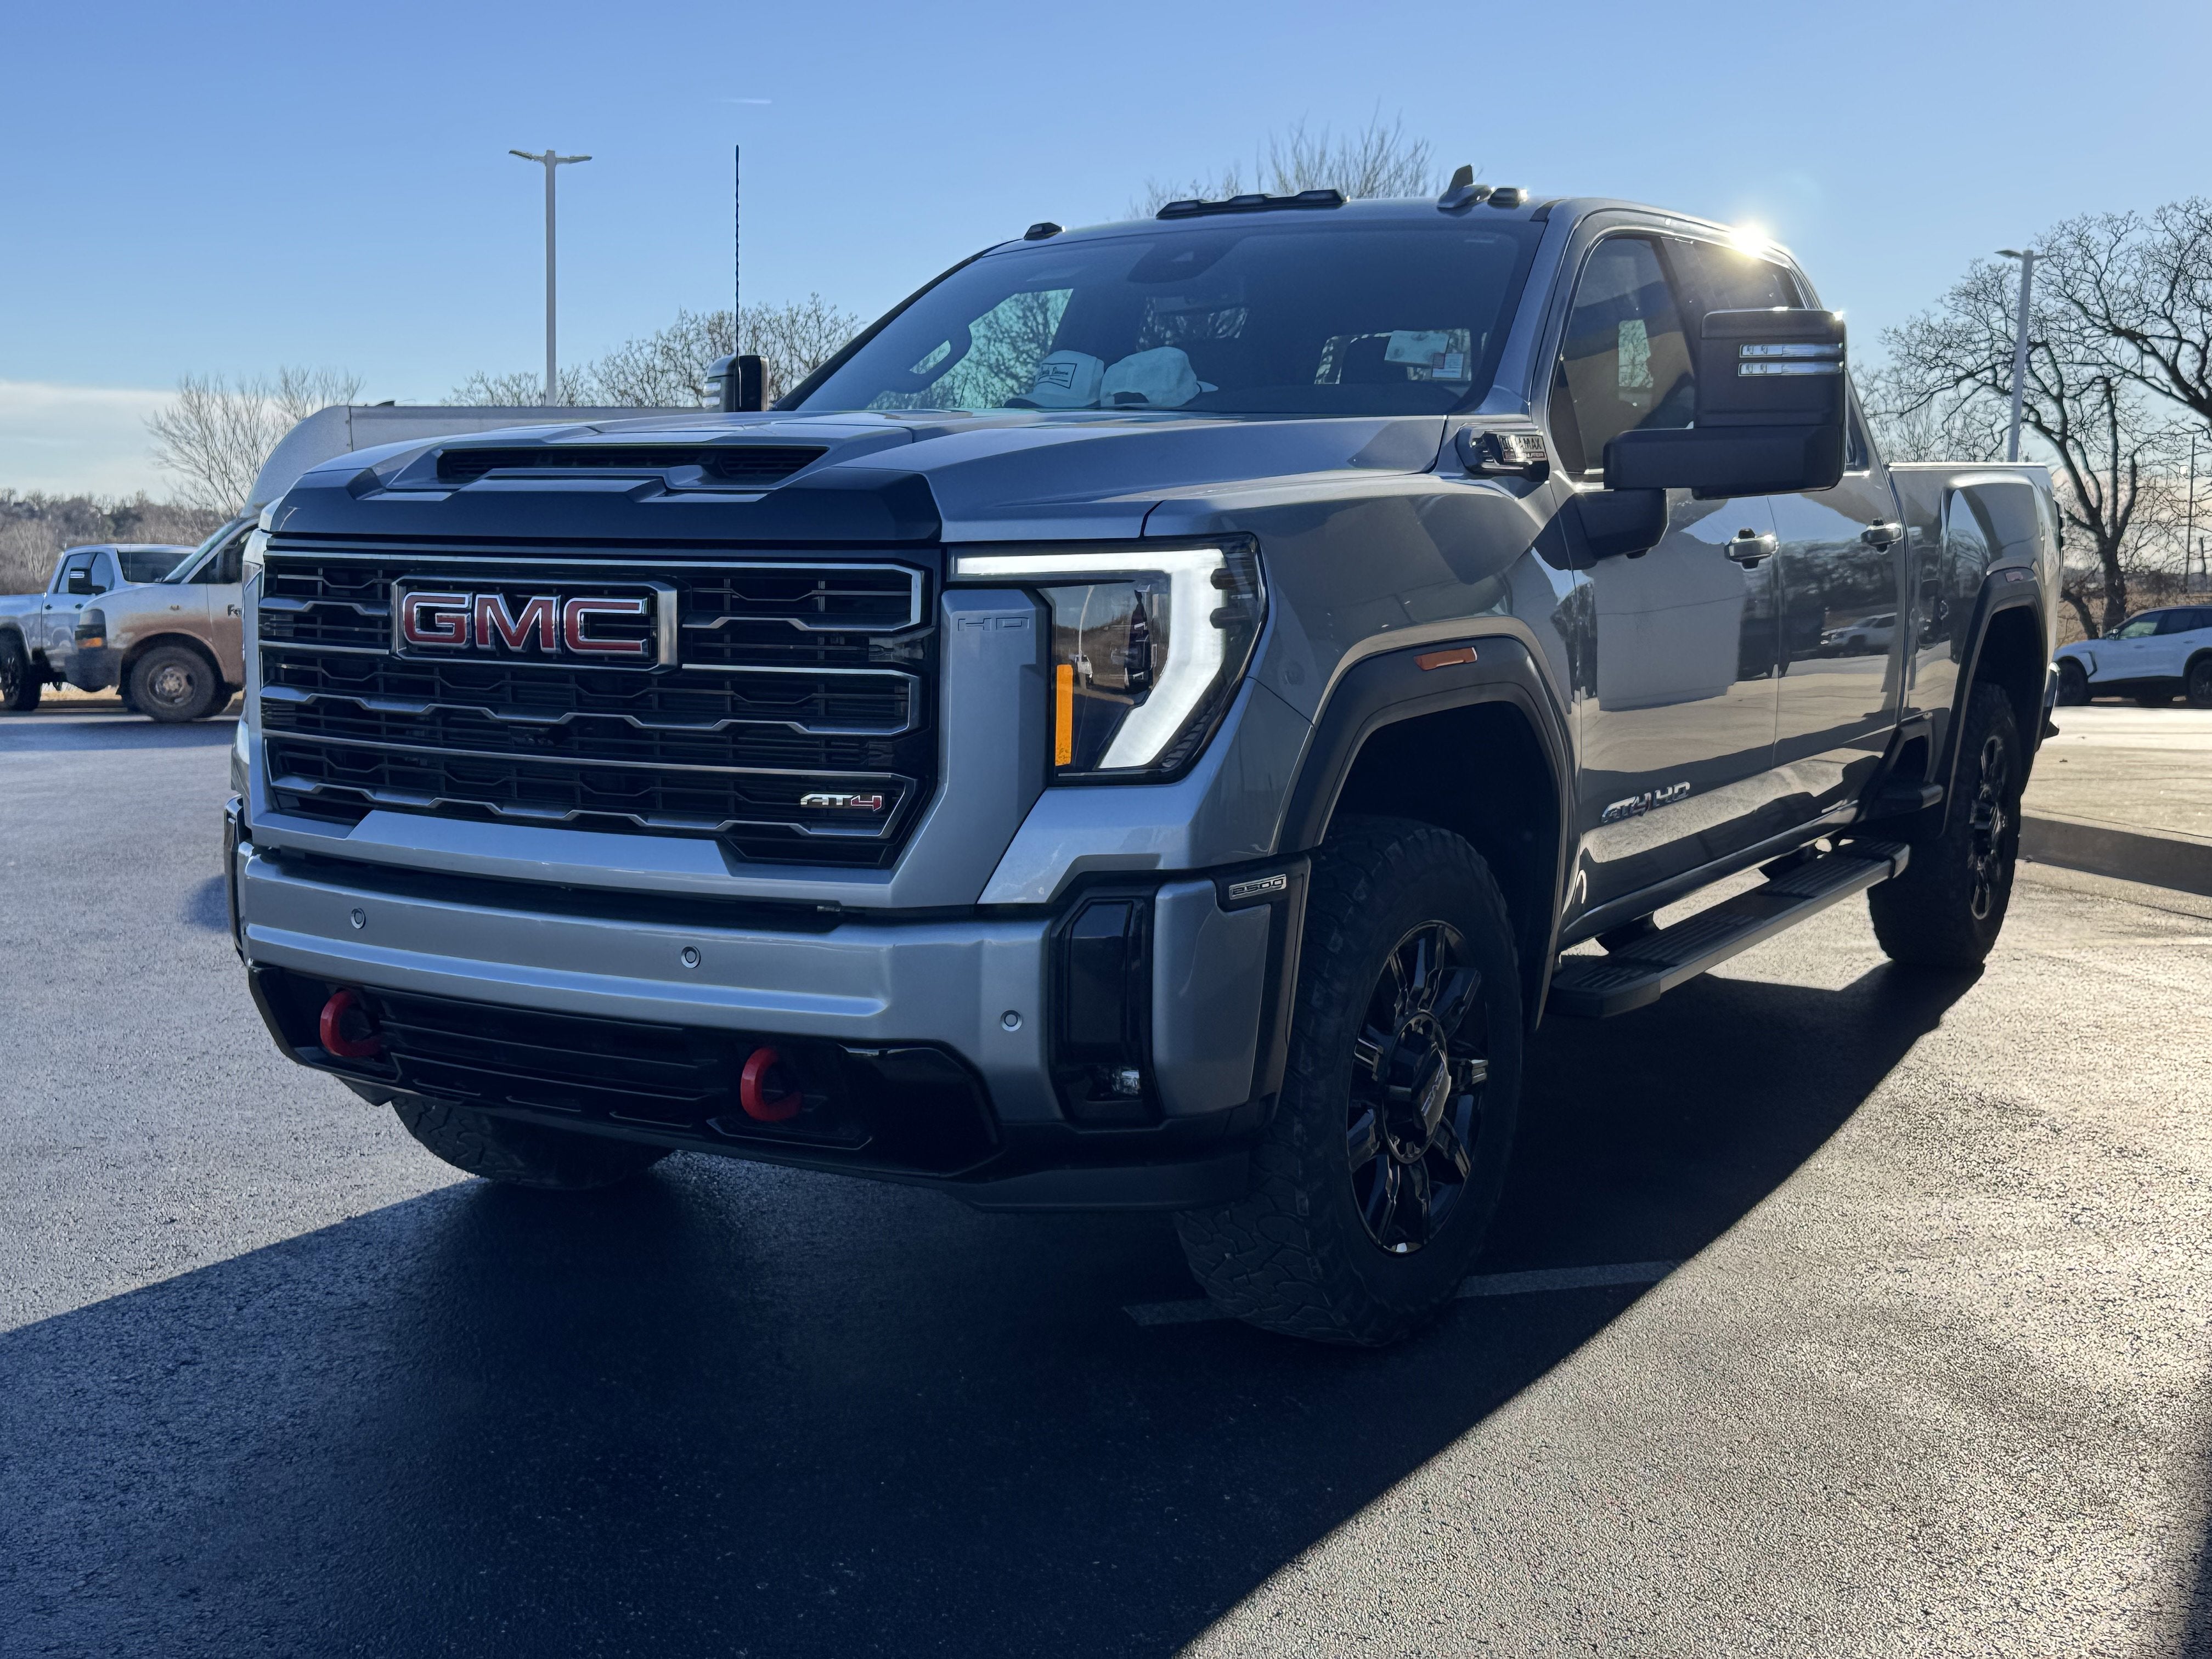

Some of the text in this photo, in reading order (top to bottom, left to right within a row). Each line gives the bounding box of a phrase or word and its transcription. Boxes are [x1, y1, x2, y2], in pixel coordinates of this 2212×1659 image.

[1499, 437, 1542, 450] DUAMAX
[403, 591, 650, 655] GMC
[958, 617, 1030, 631] HD
[800, 793, 882, 812] AT4
[1232, 878, 1284, 895] 2500
